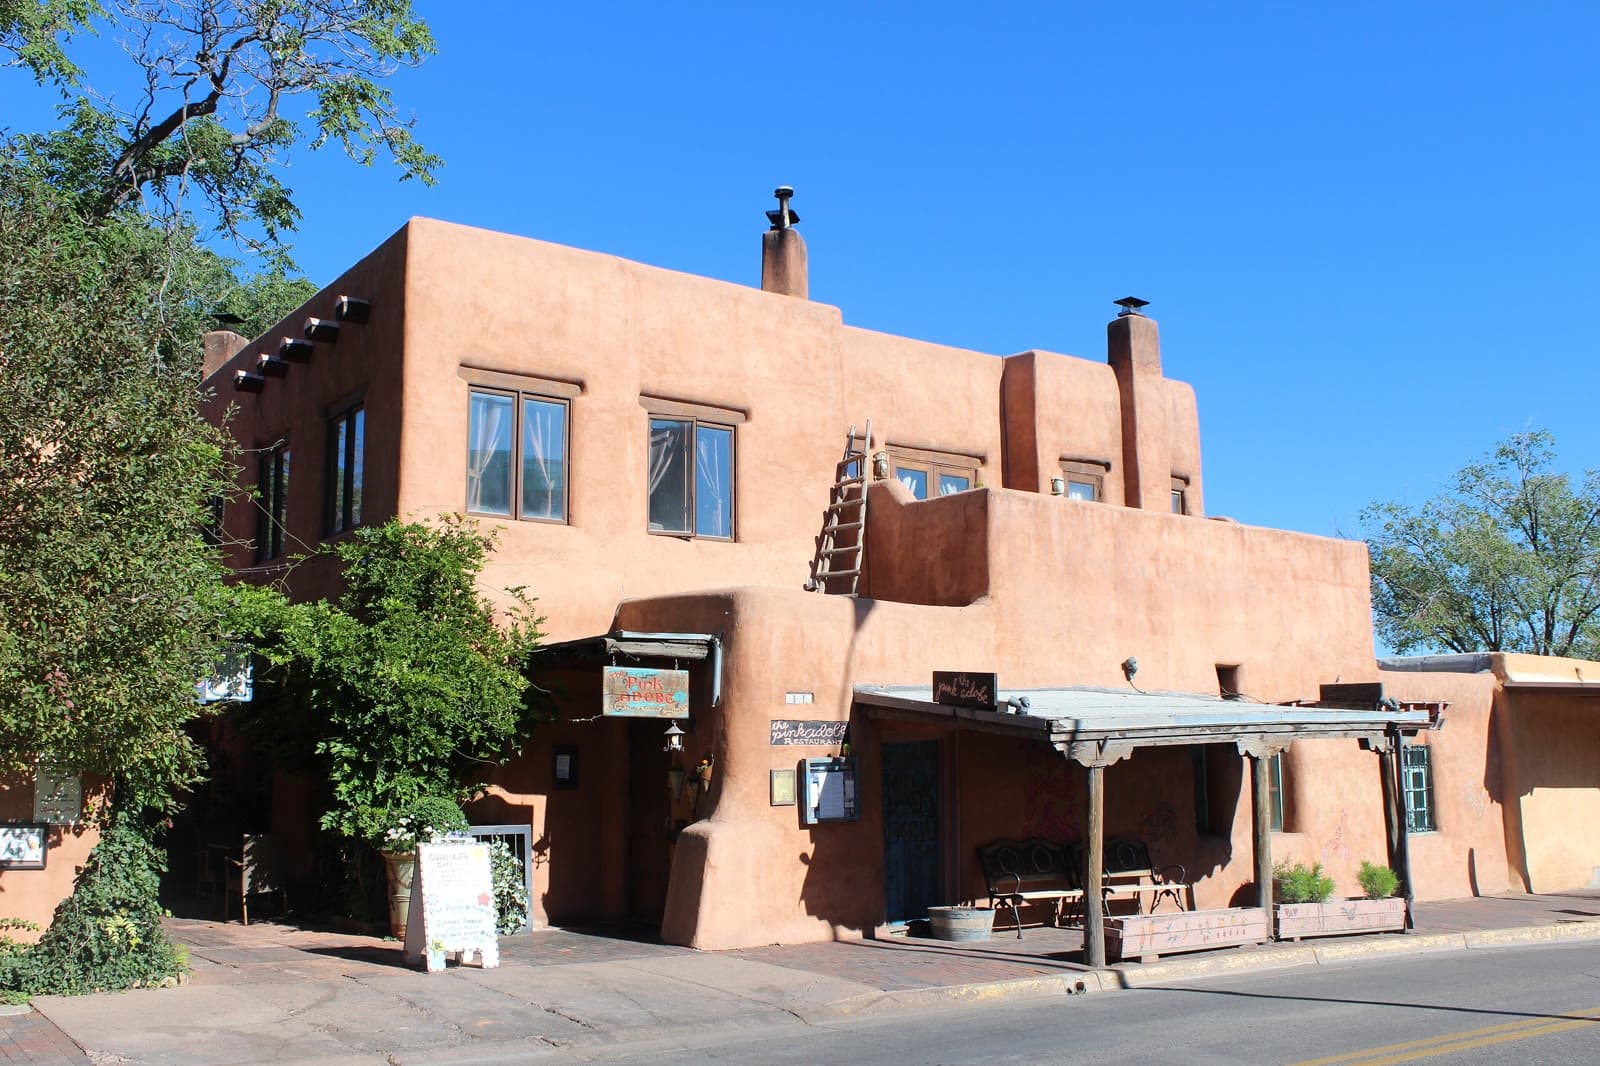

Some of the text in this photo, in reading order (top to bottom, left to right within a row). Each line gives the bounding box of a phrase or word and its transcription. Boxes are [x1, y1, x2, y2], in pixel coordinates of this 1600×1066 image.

[625, 676, 664, 691] Pink
[772, 721, 789, 731] the
[784, 737, 843, 745] RESTAURANT
